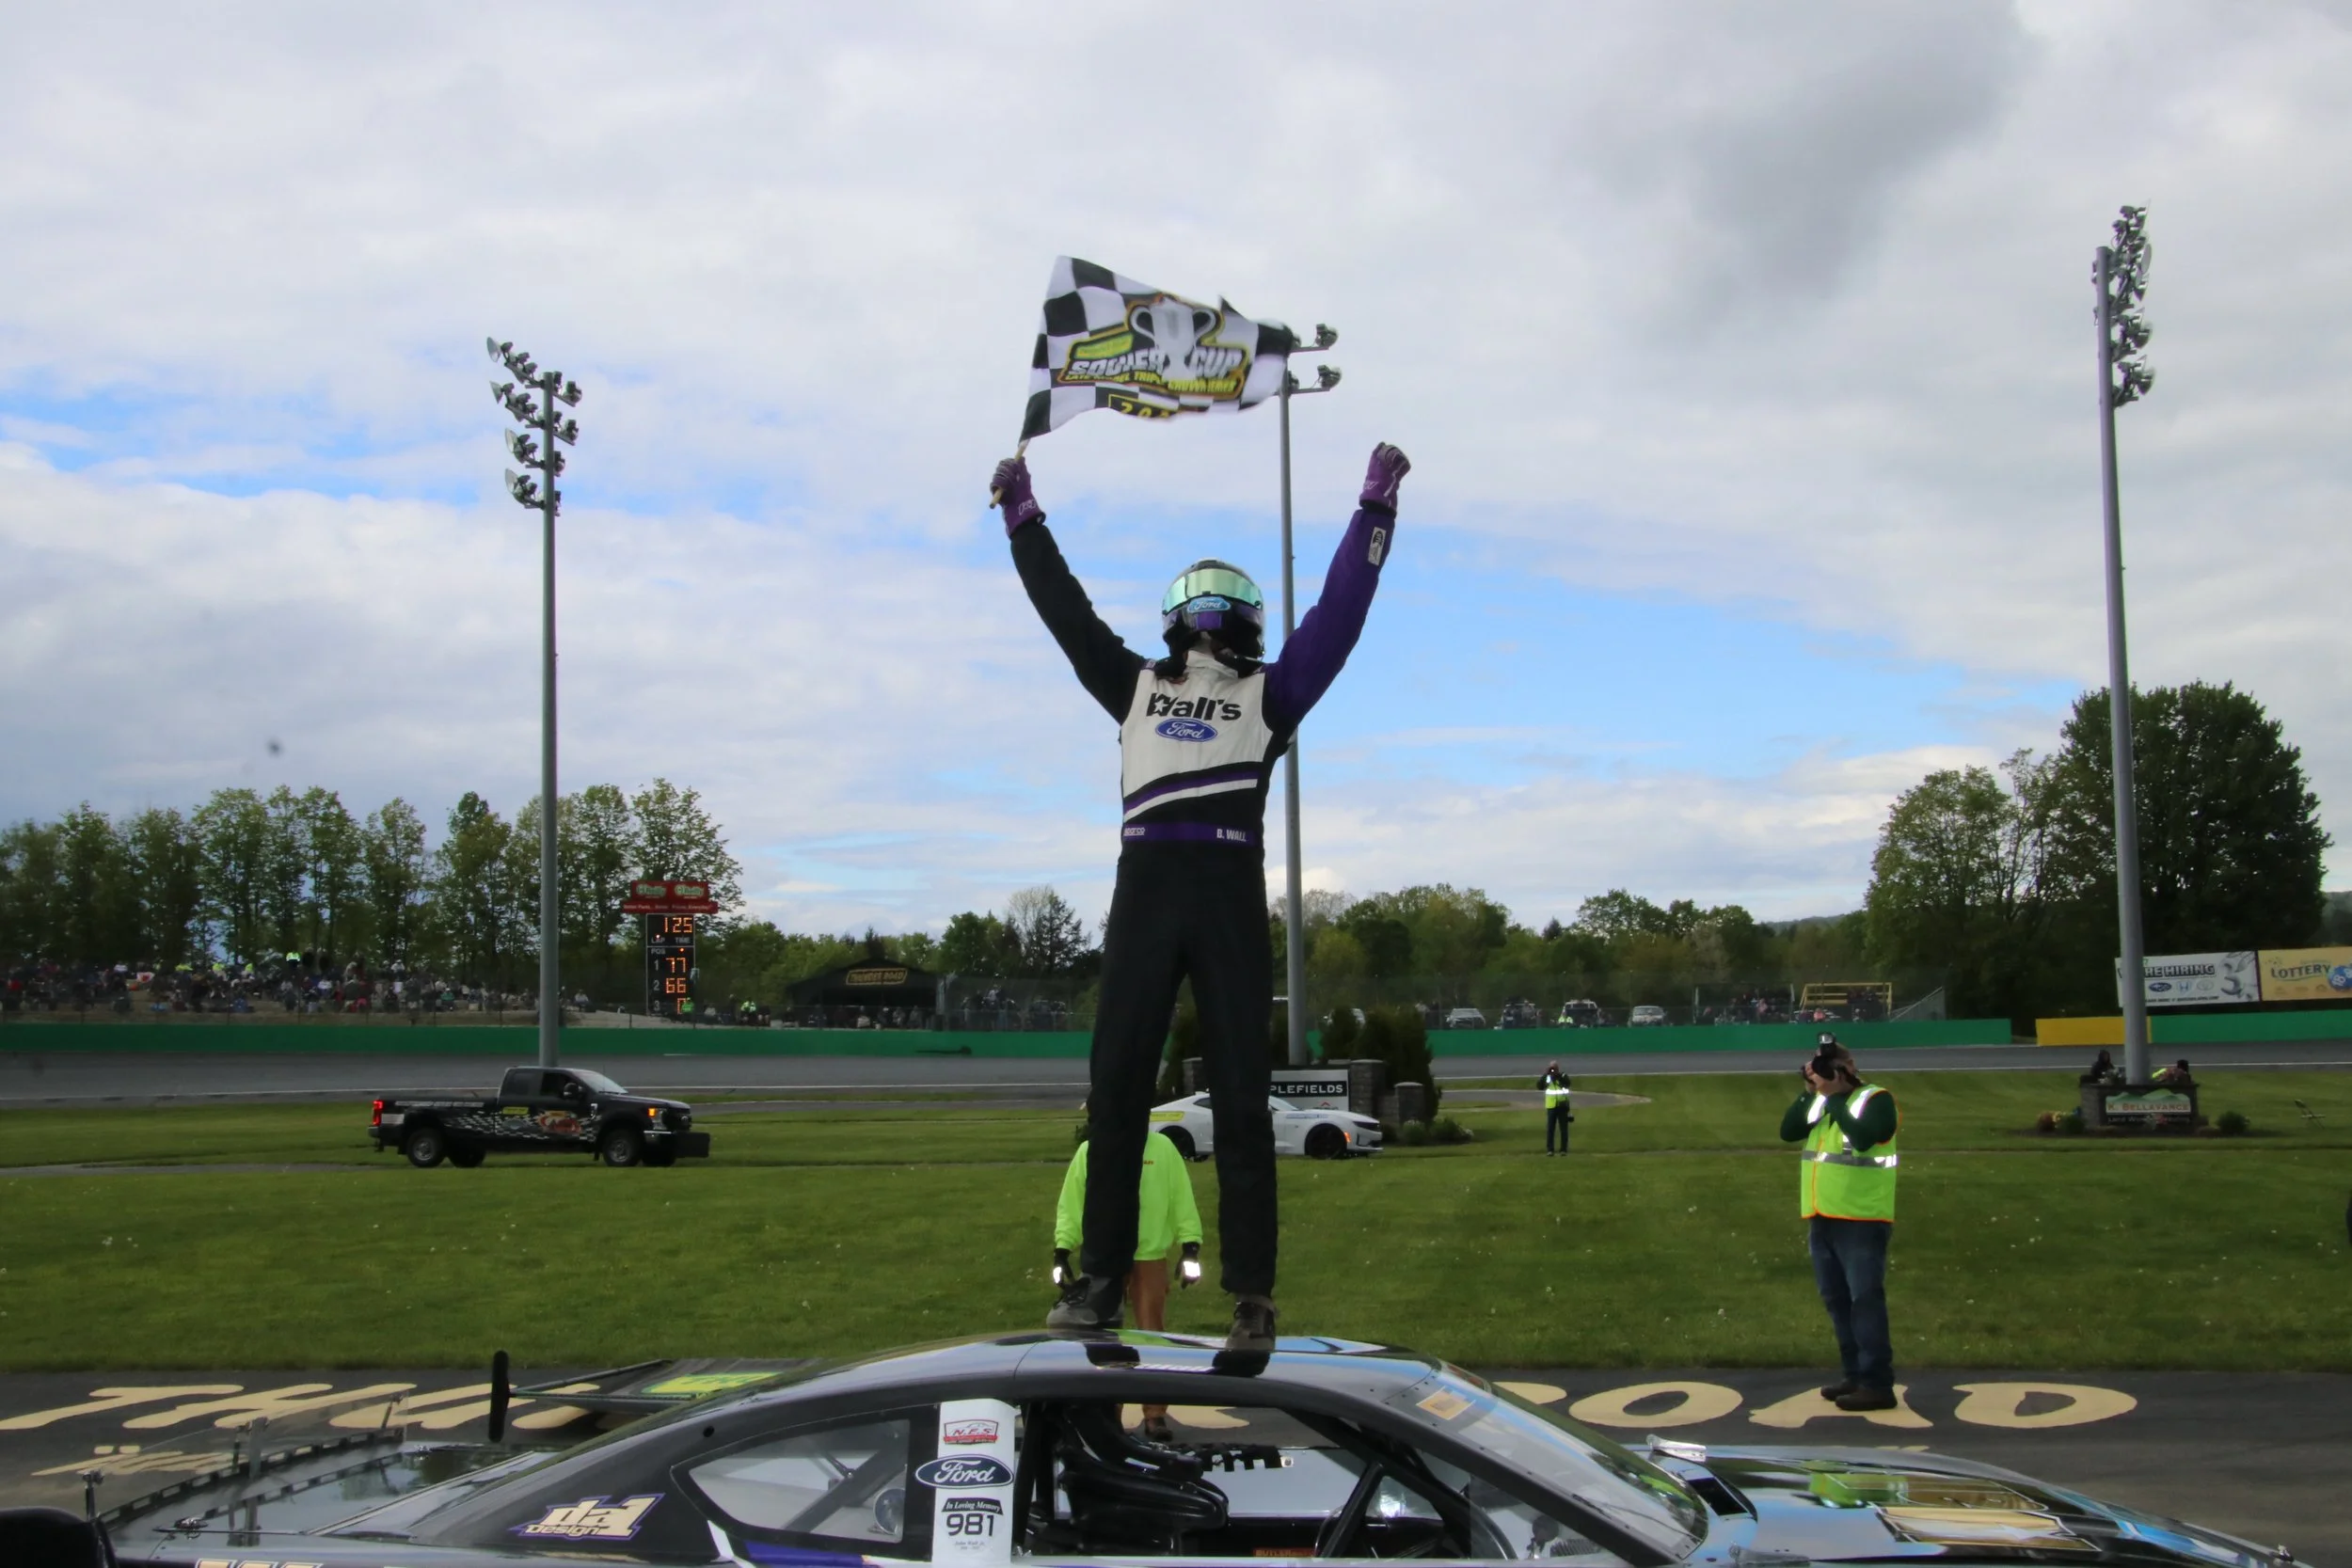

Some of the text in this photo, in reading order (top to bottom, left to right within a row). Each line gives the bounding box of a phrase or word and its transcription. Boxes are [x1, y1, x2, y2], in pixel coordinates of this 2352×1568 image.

[1187, 346, 1243, 379] CUP
[1194, 598, 1222, 610] Ford
[1146, 692, 1242, 721] Wall's
[1167, 721, 1205, 739] Ford
[1216, 829, 1247, 842] B. WALL
[663, 917, 692, 933] 125
[654, 959, 660, 971] 1
[665, 957, 686, 973] 77
[2164, 963, 2216, 977] HIRING
[2271, 964, 2330, 978] LOTTERY
[653, 980, 660, 990] 2
[666, 977, 686, 993] 66
[654, 1000, 660, 1011] 3
[1270, 1084, 1343, 1094] PLEFIELDS
[933, 1460, 994, 1483] Ford
[954, 1500, 975, 1511] Loving
[977, 1500, 1001, 1513] Memory
[525, 1525, 601, 1537] Design
[946, 1513, 994, 1537] 981
